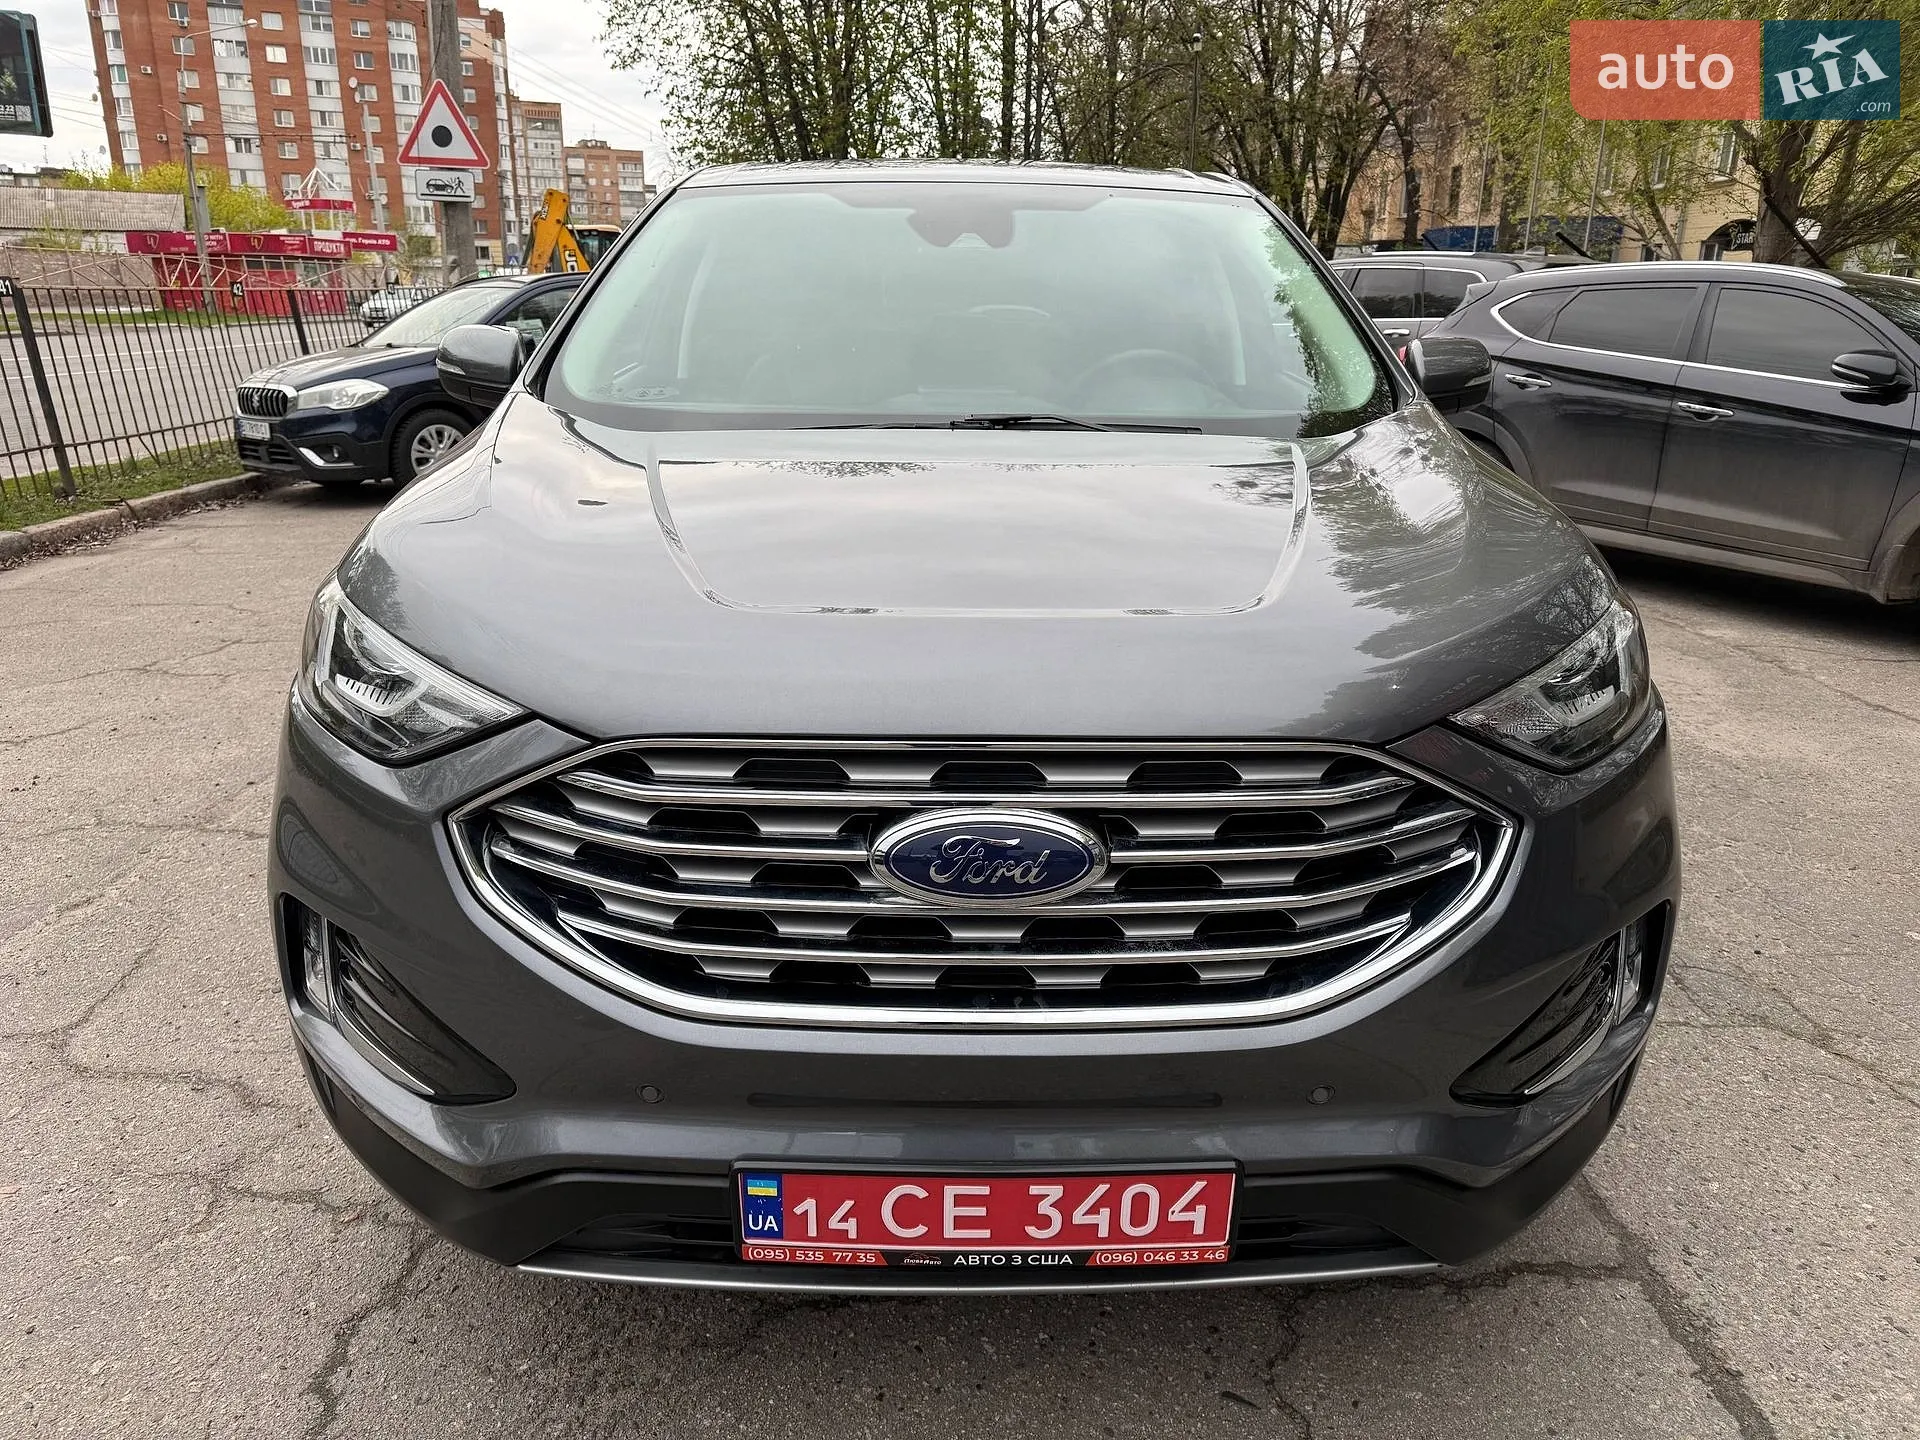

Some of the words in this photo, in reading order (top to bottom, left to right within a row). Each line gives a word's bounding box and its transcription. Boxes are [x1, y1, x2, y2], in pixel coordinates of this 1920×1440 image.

[314, 241, 344, 252] ПРОДУКТИ
[0, 280, 12, 294] 41
[233, 283, 243, 296] 42
[929, 835, 1050, 884] Ford
[792, 1197, 857, 1239] 14
[881, 1185, 990, 1239] CE
[1024, 1180, 1208, 1239] 3404
[748, 1214, 779, 1232] UA
[748, 1247, 790, 1262] (095)
[795, 1250, 824, 1262] 535
[832, 1251, 852, 1263] 77
[855, 1252, 876, 1263] 35
[953, 1254, 1006, 1266] АВТО
[1027, 1254, 1073, 1266] США
[1095, 1250, 1138, 1265] (096)
[1143, 1250, 1176, 1263] 046
[1180, 1250, 1199, 1262] 33
[1203, 1249, 1225, 1260] 46
